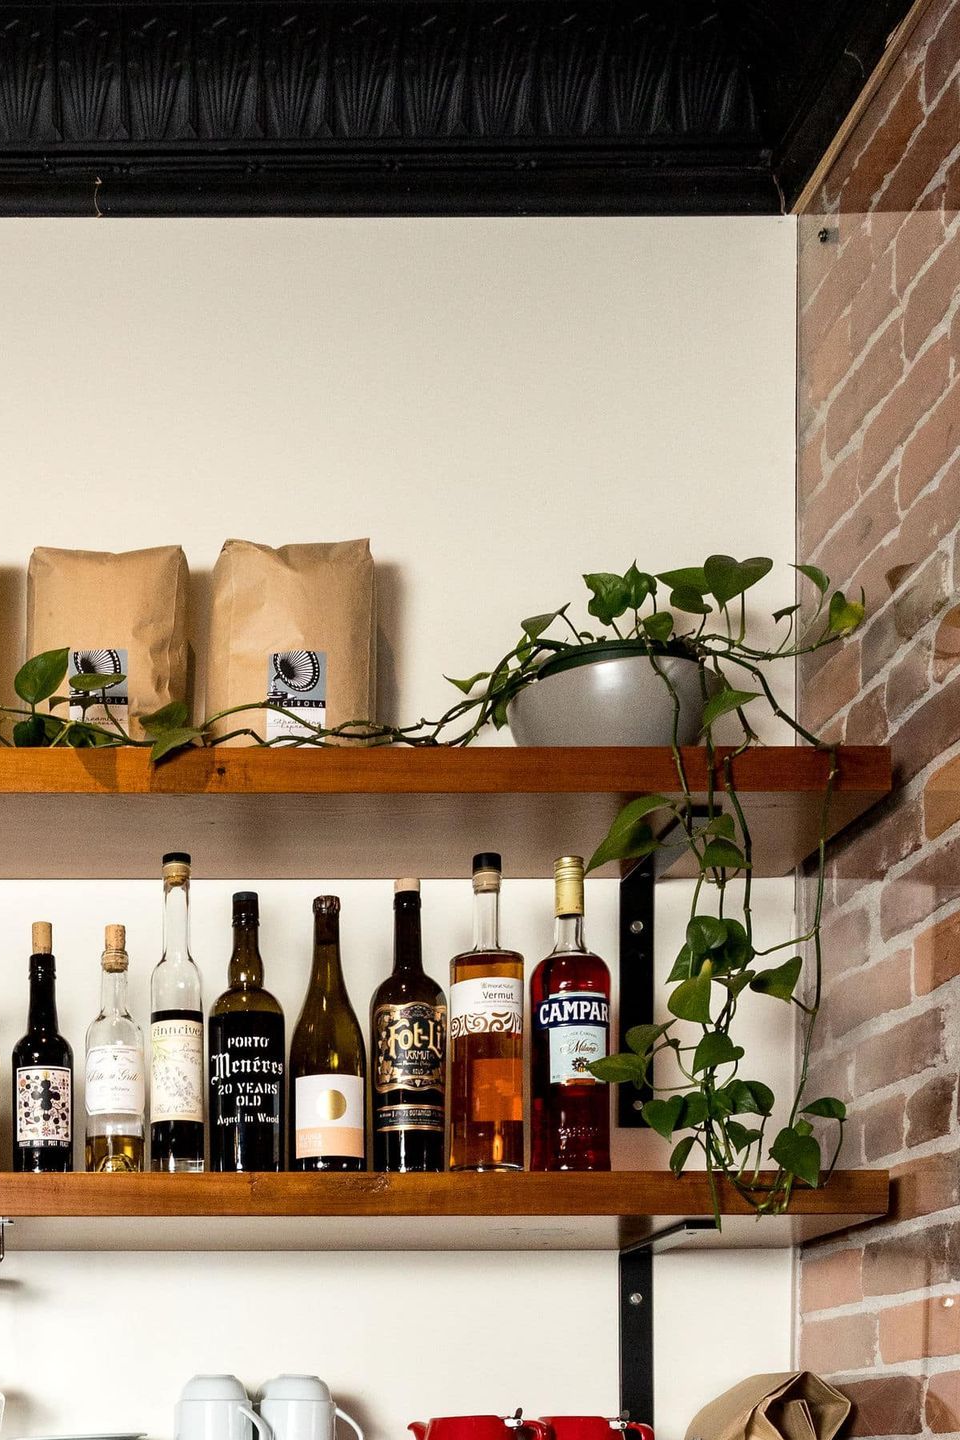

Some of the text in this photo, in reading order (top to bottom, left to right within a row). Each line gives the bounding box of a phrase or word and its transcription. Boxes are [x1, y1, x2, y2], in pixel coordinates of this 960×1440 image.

[483, 991, 514, 1000] Vermut
[152, 1025, 202, 1037] innrive
[227, 1036, 269, 1049] PORTO
[388, 1018, 443, 1060] Fot-Li
[404, 1050, 431, 1060] VERMUT
[211, 1052, 283, 1086] Menéres
[218, 1082, 278, 1096] 20 YEARS
[235, 1095, 261, 1107] OLD
[216, 1112, 280, 1127] Aged in Wood
